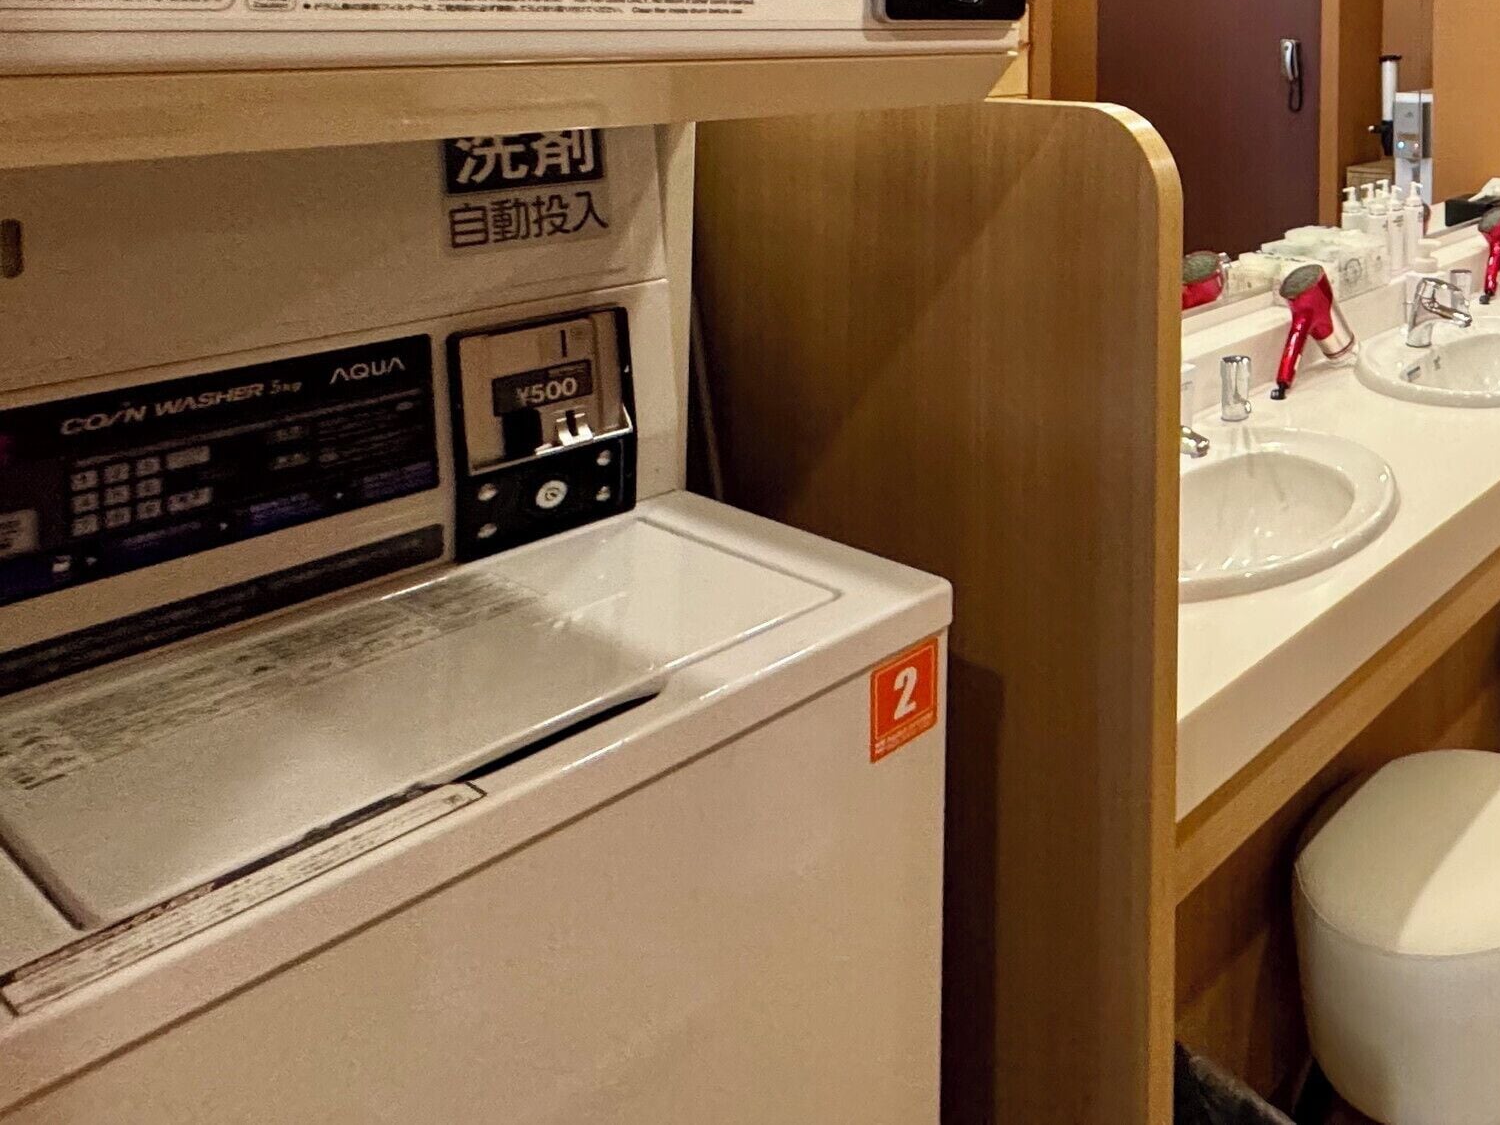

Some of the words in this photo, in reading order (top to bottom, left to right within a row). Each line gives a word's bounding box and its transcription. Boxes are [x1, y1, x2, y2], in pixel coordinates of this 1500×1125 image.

[455, 128, 596, 185] 洗剤
[448, 190, 610, 249] 自動投入
[329, 356, 406, 386] AQUA
[515, 376, 579, 405] ¥500
[153, 383, 266, 416] WASHER
[893, 665, 919, 721] 2
